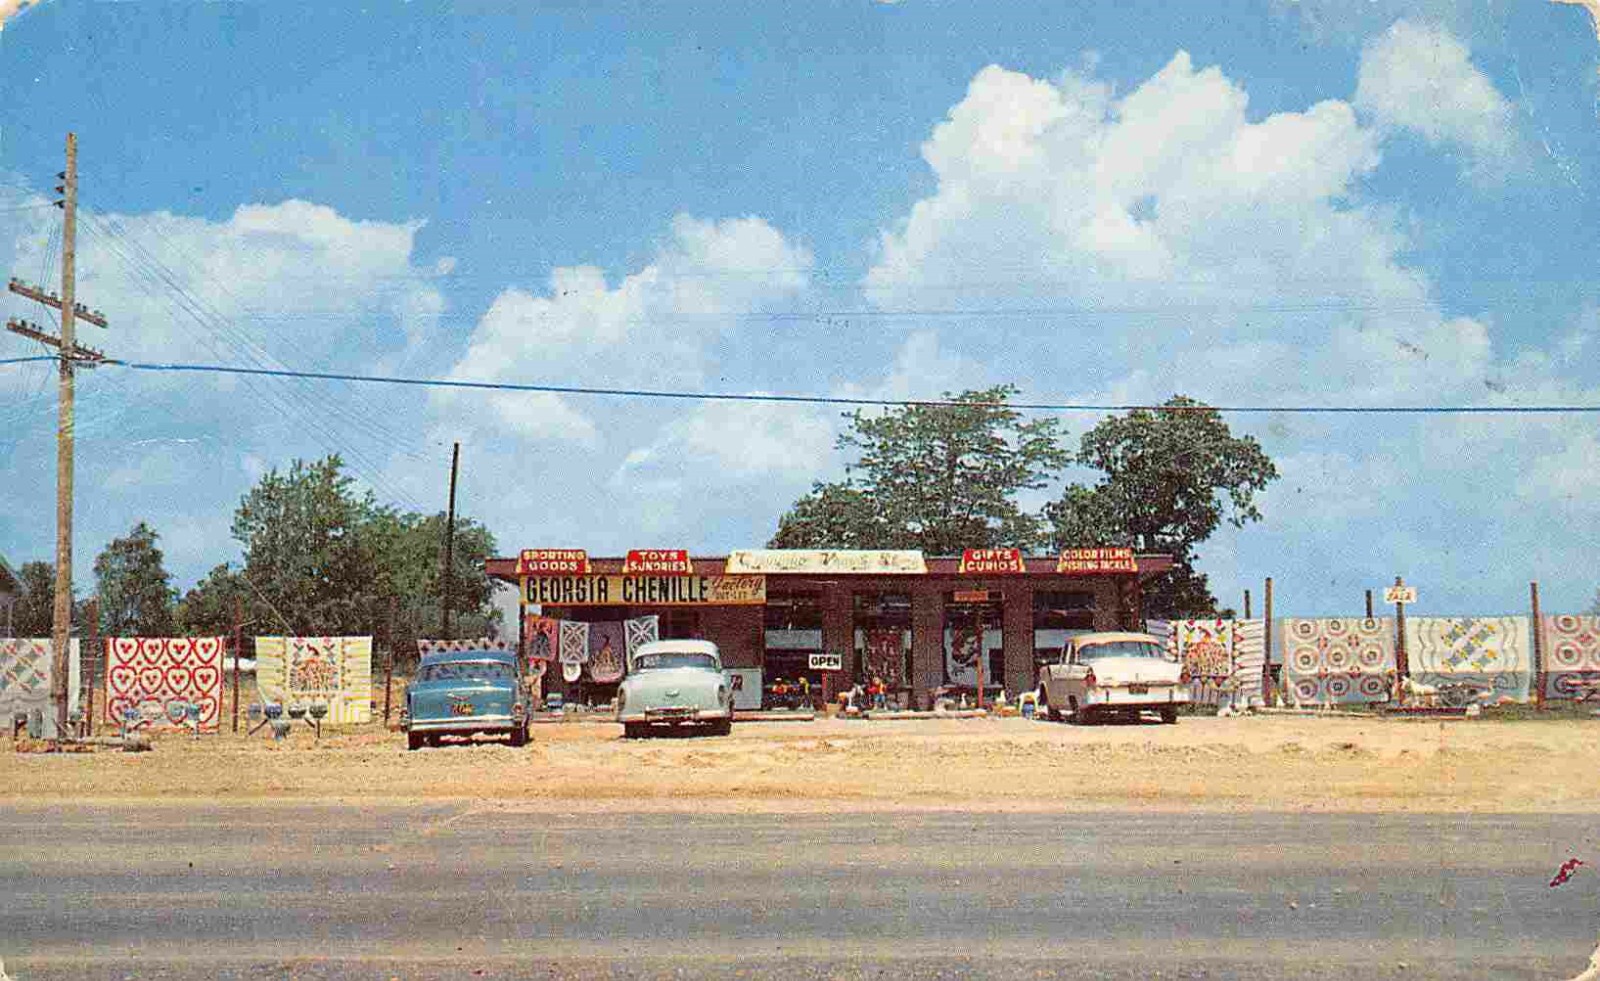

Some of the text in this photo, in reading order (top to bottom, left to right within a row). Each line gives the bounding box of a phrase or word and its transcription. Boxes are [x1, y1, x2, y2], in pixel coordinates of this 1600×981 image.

[523, 551, 585, 560] SPORTING
[638, 551, 678, 560] TOYS
[972, 550, 1012, 560] GIFTS
[1062, 548, 1131, 560] COLOR FILMS
[528, 561, 578, 571] GOODS
[630, 561, 686, 571] SUNDRIES
[966, 561, 1018, 571] CURIOS
[527, 576, 763, 603] GEORGIA CHENILLE Factory
[811, 656, 840, 667] OPEN
